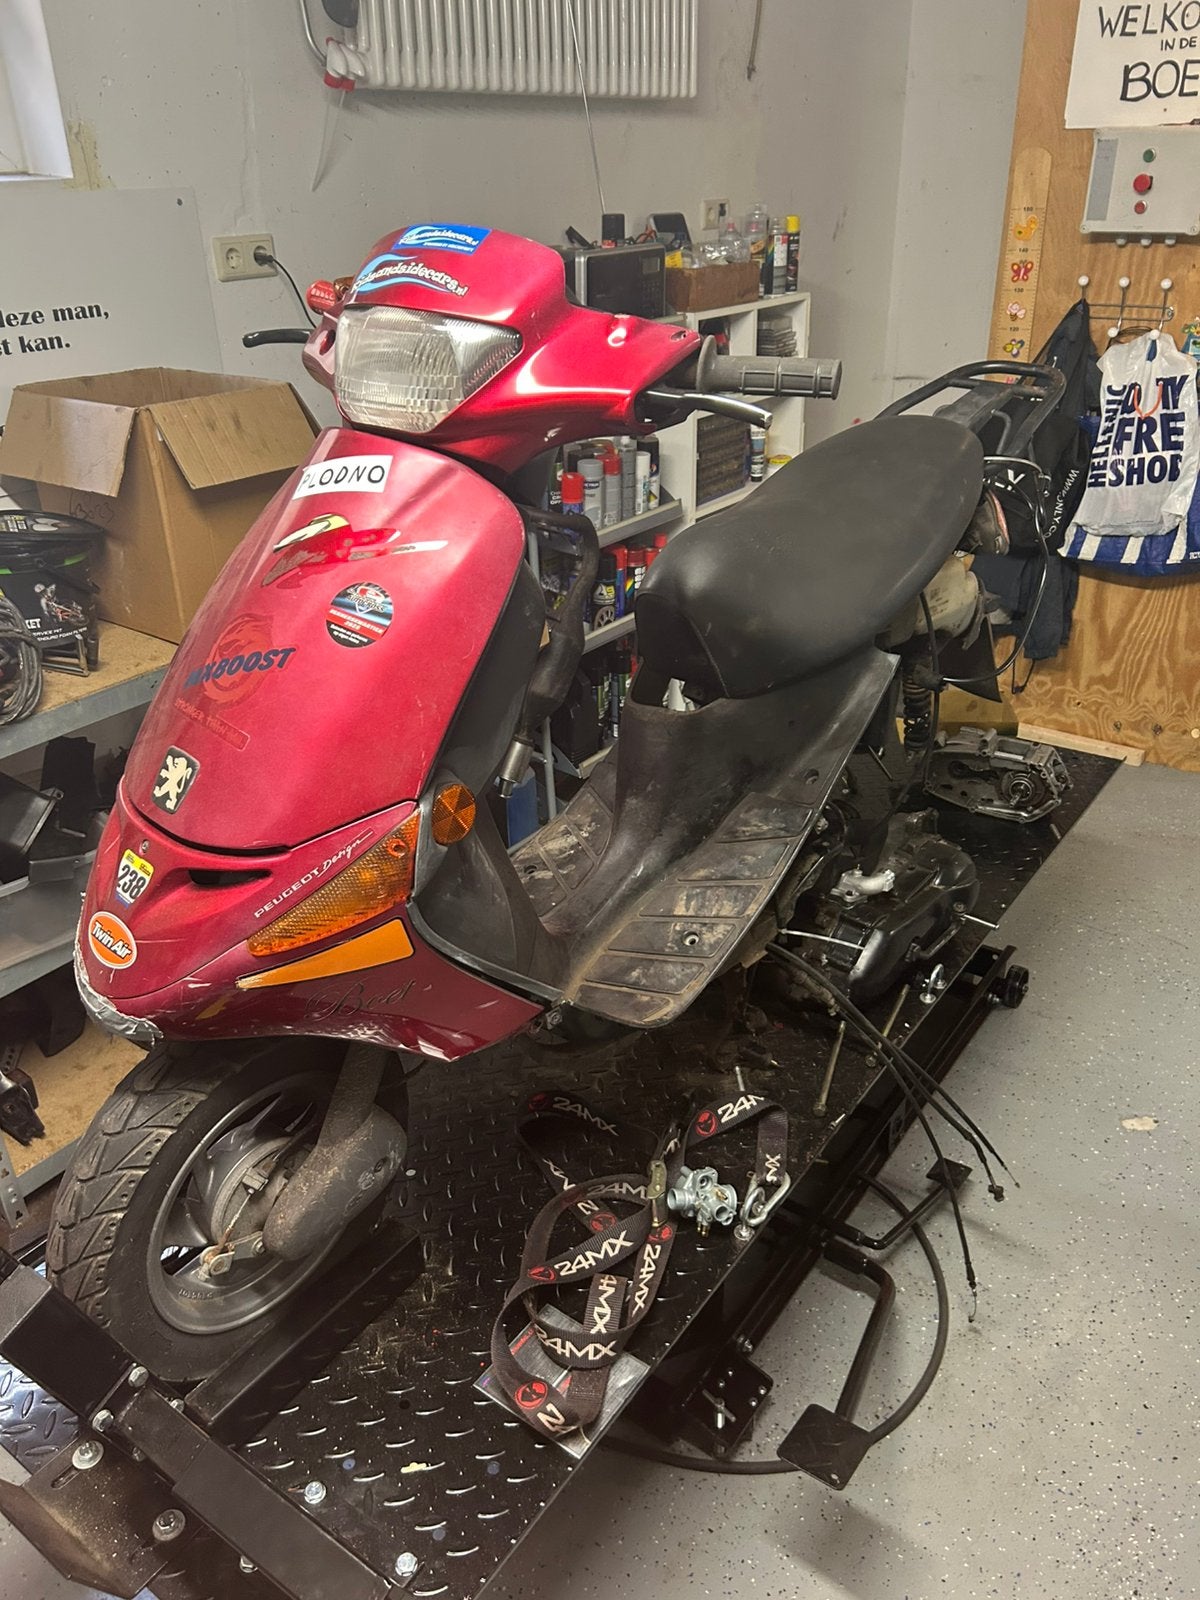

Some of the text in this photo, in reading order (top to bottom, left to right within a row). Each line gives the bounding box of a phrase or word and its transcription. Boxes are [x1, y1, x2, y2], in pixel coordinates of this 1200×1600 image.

[1098, 1, 1200, 38] WELKO
[1160, 36, 1198, 52] IN DE
[1120, 60, 1200, 102] BOE
[52, 304, 109, 322] man,
[18, 335, 70, 353] kan.
[298, 465, 386, 492] PLODNO
[117, 864, 147, 900] 238
[254, 831, 374, 918] PEUGEOT Design
[92, 920, 133, 960] Twin Air
[552, 1096, 619, 1137] 24MX
[553, 1230, 634, 1277] 24MX
[631, 1243, 662, 1319] 24MX
[533, 1321, 617, 1361] 24MX
